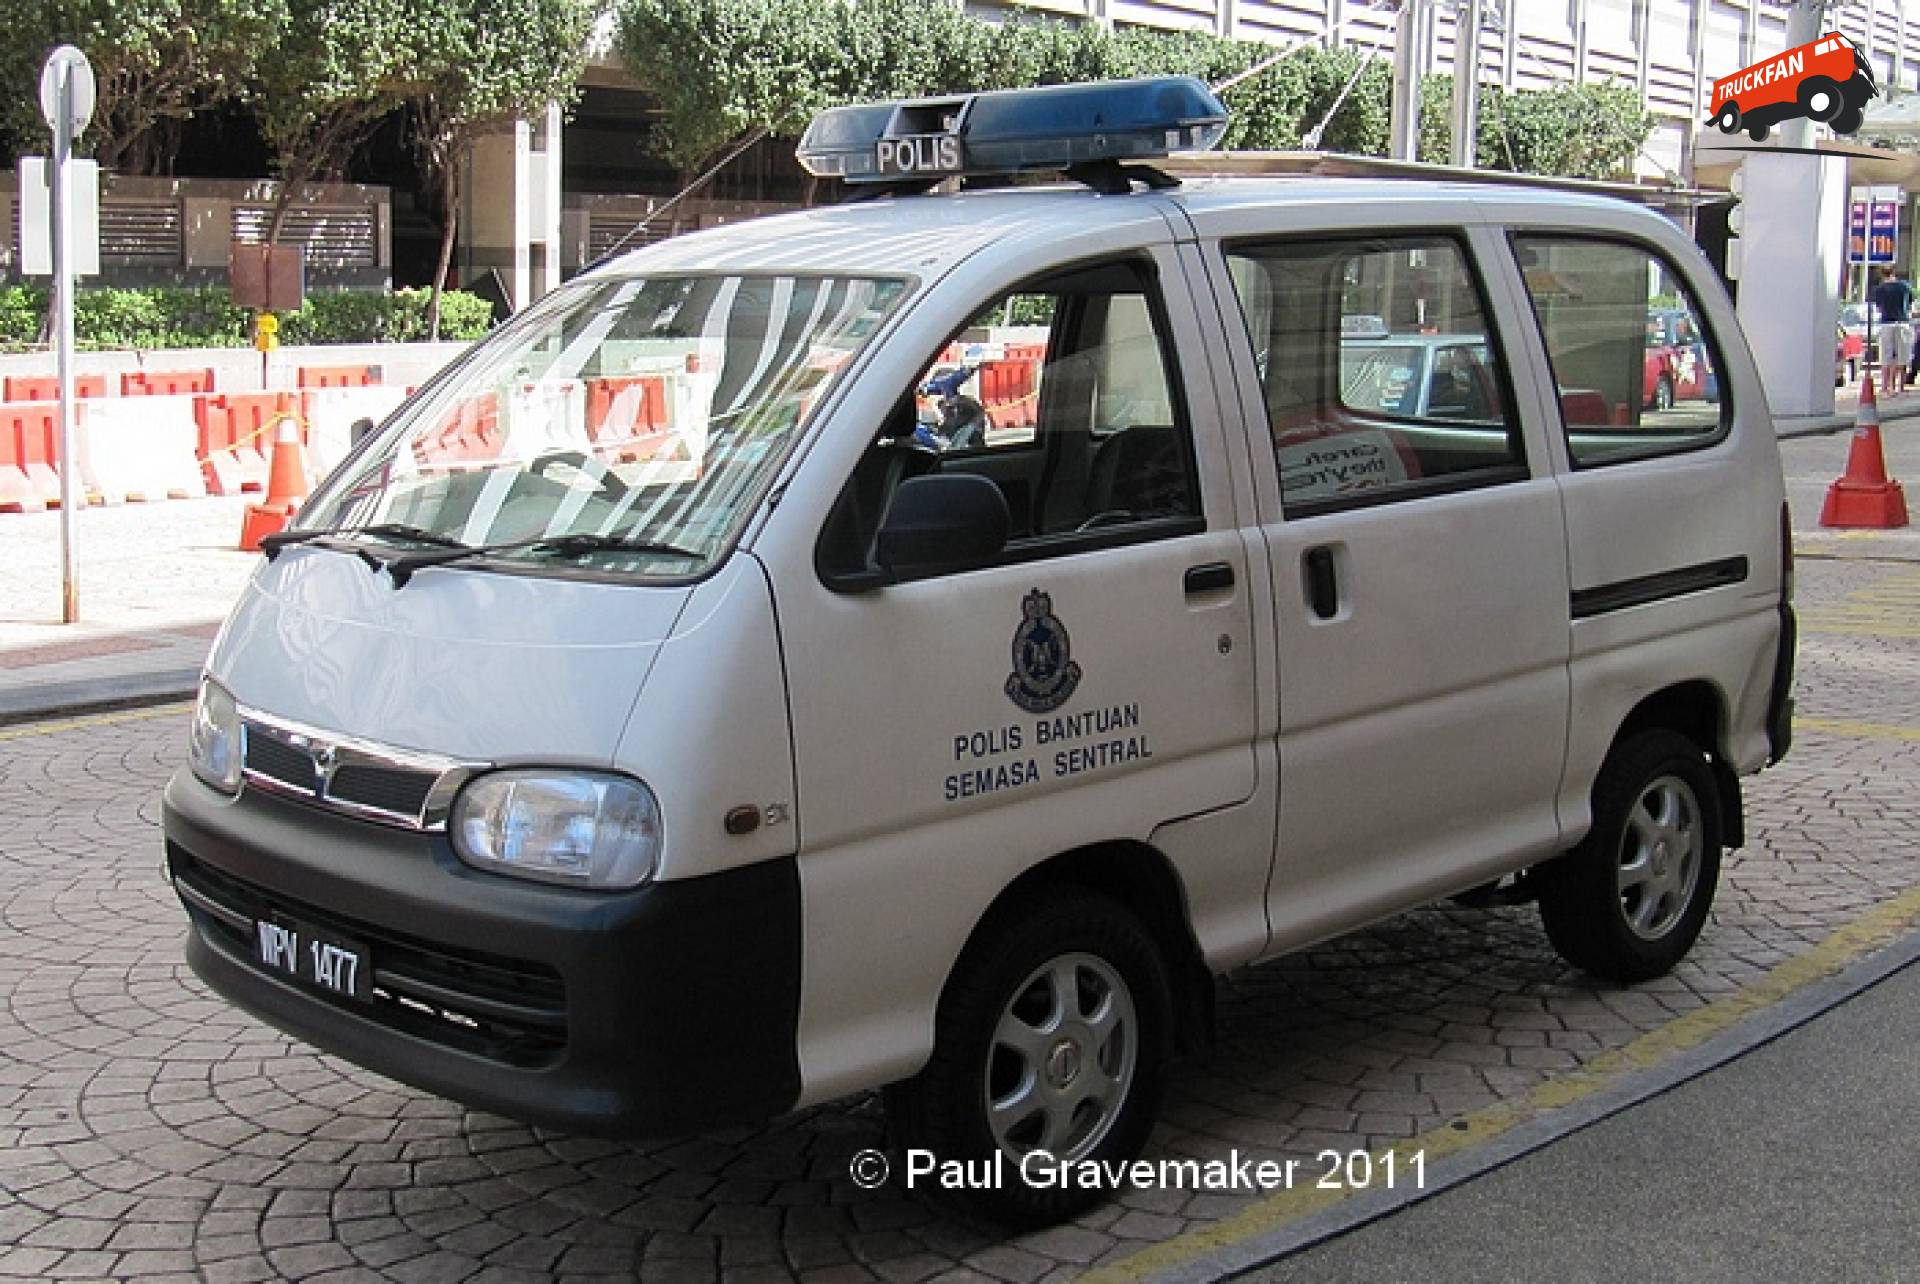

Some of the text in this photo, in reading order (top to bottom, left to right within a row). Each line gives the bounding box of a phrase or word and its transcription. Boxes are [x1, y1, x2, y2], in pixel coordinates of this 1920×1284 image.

[877, 136, 959, 173] POLIS
[954, 703, 1139, 760] POLIS BANTUAN
[945, 735, 1153, 801] SEMASA SENTRAL
[310, 940, 358, 997] 1477
